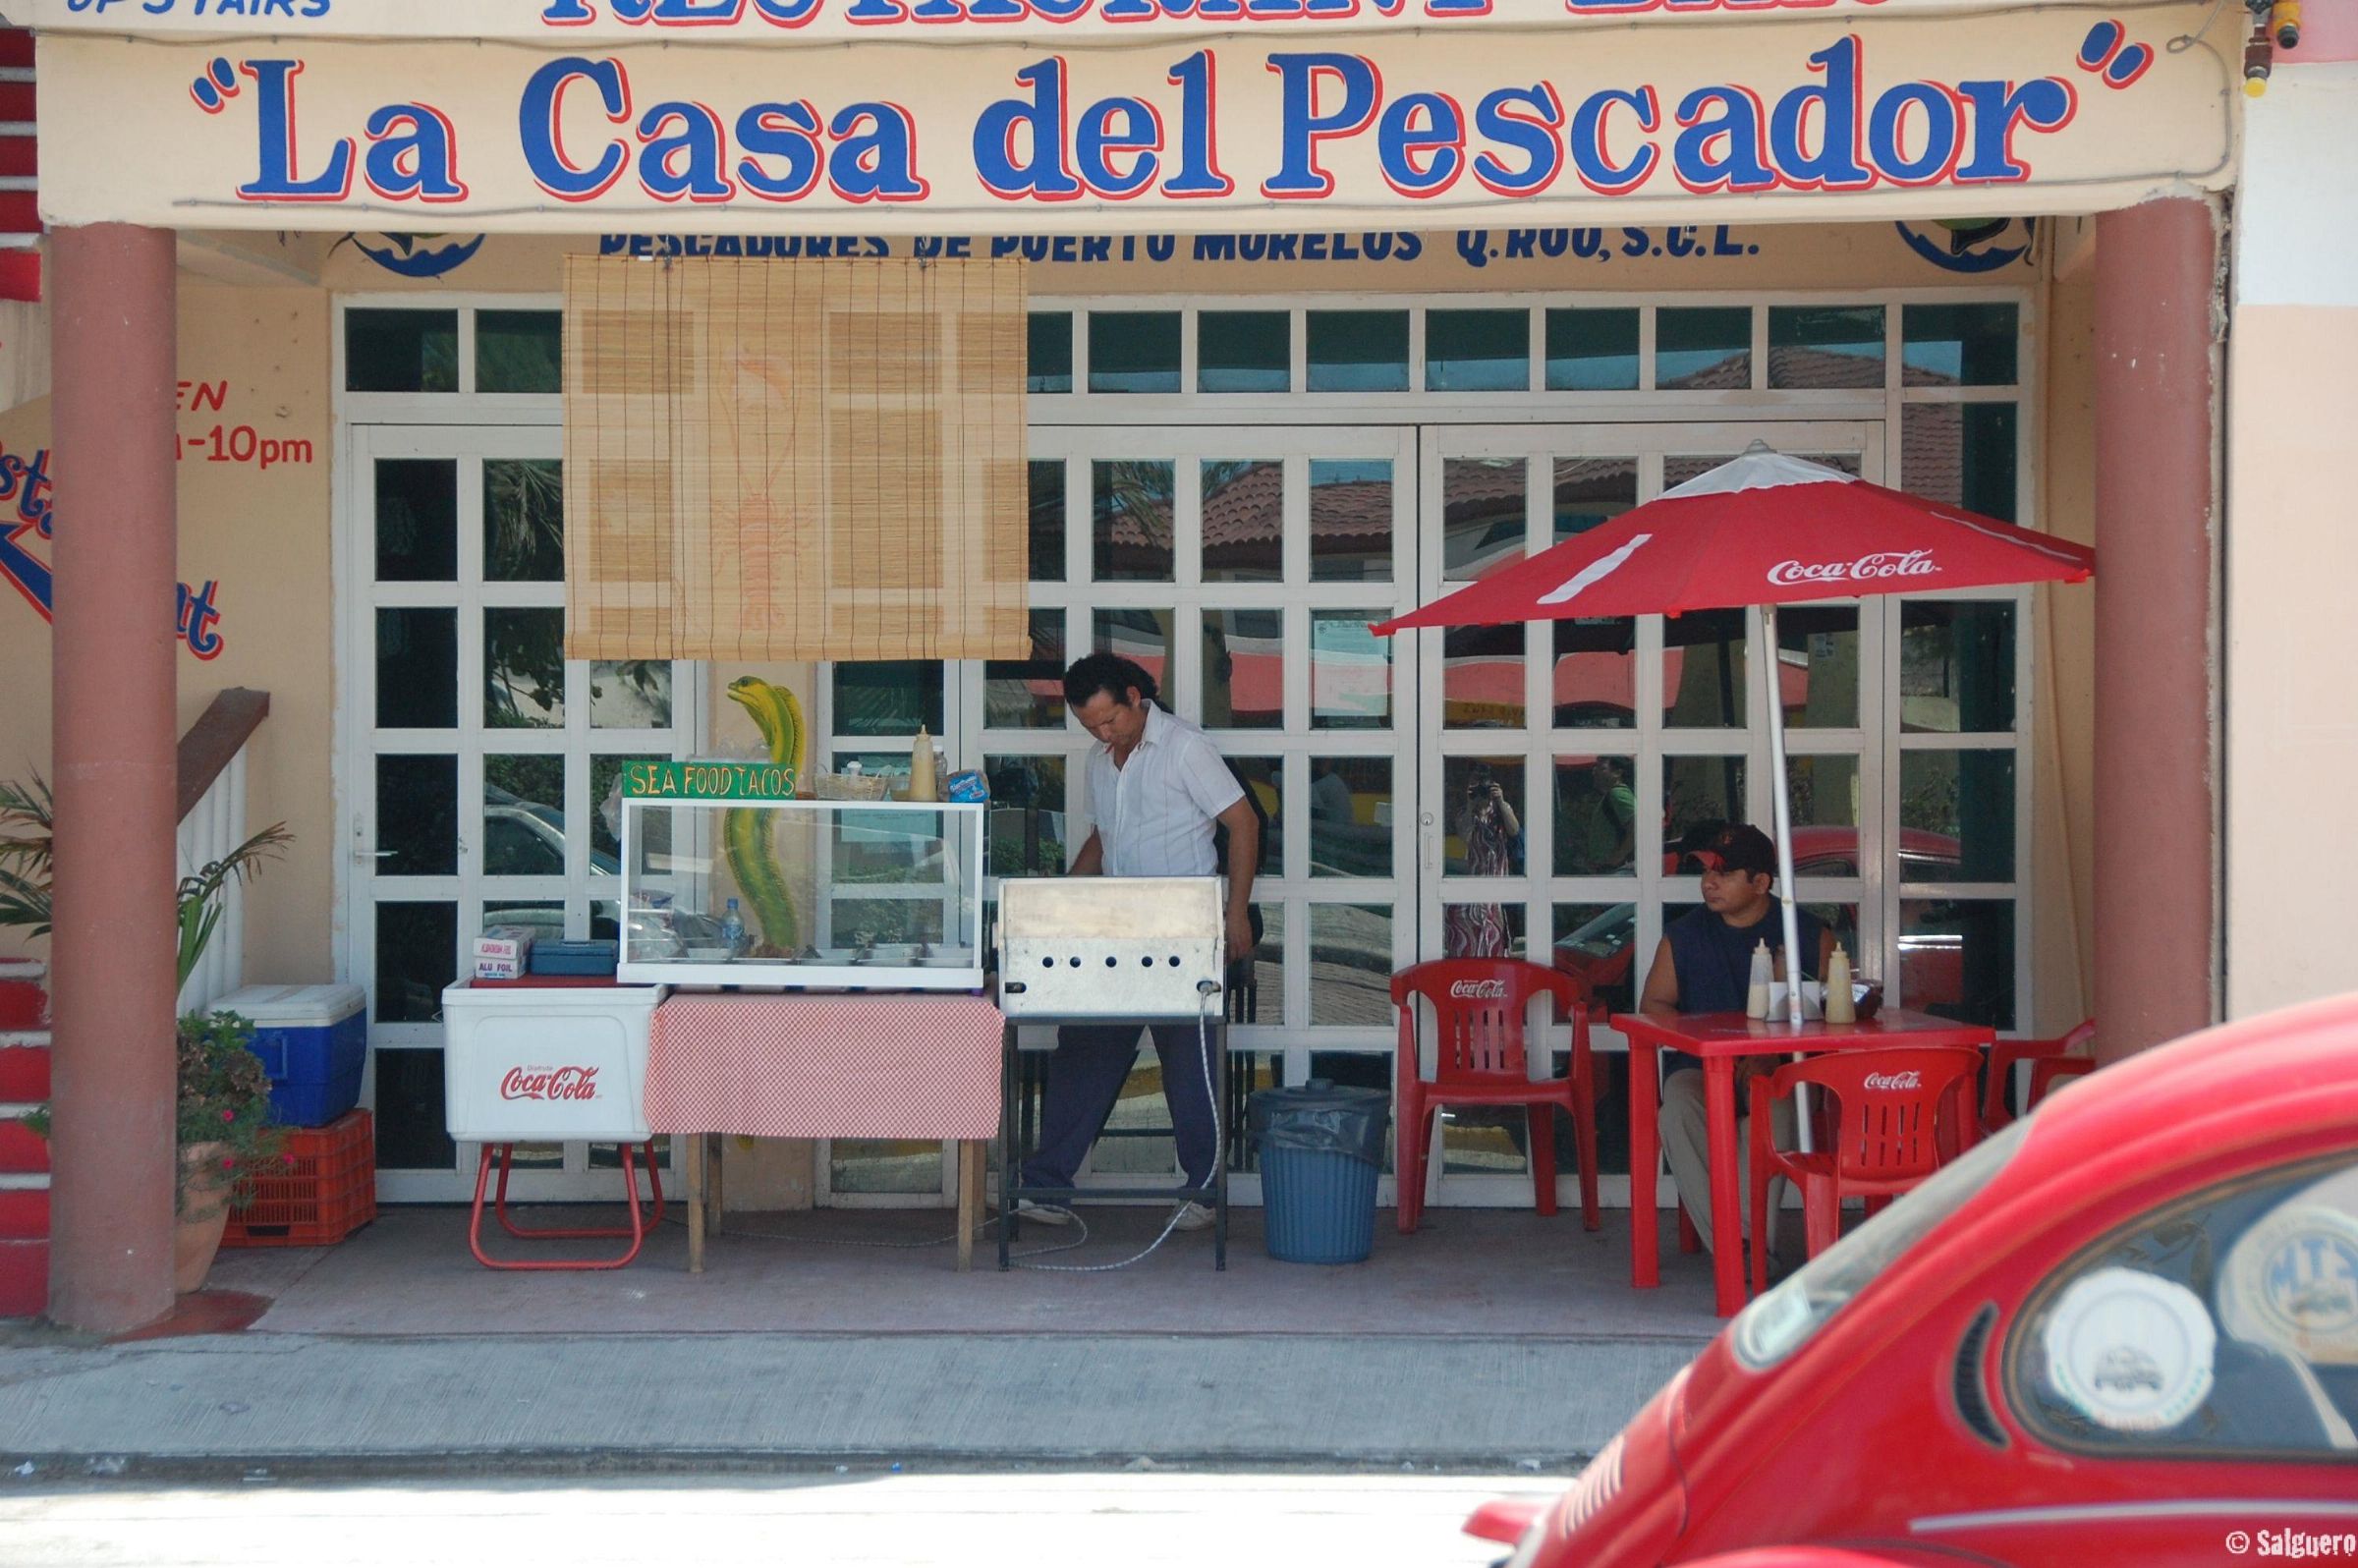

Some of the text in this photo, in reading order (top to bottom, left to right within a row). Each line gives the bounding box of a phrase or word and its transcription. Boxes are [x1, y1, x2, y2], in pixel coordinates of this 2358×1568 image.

[519, 56, 930, 202] Casa
[973, 48, 1235, 201] del
[990, 235, 1175, 262] PUERTO
[1192, 231, 1423, 261] MORELOS
[1767, 548, 1934, 586] Coca-Cola
[630, 765, 795, 796] SEA FOOD TACOS
[478, 962, 513, 973] ALU FOIL
[1450, 980, 1505, 998] Coca-Cola
[500, 1066, 600, 1100] Coca-Cola
[1863, 1071, 1920, 1090] Coca-Cola
